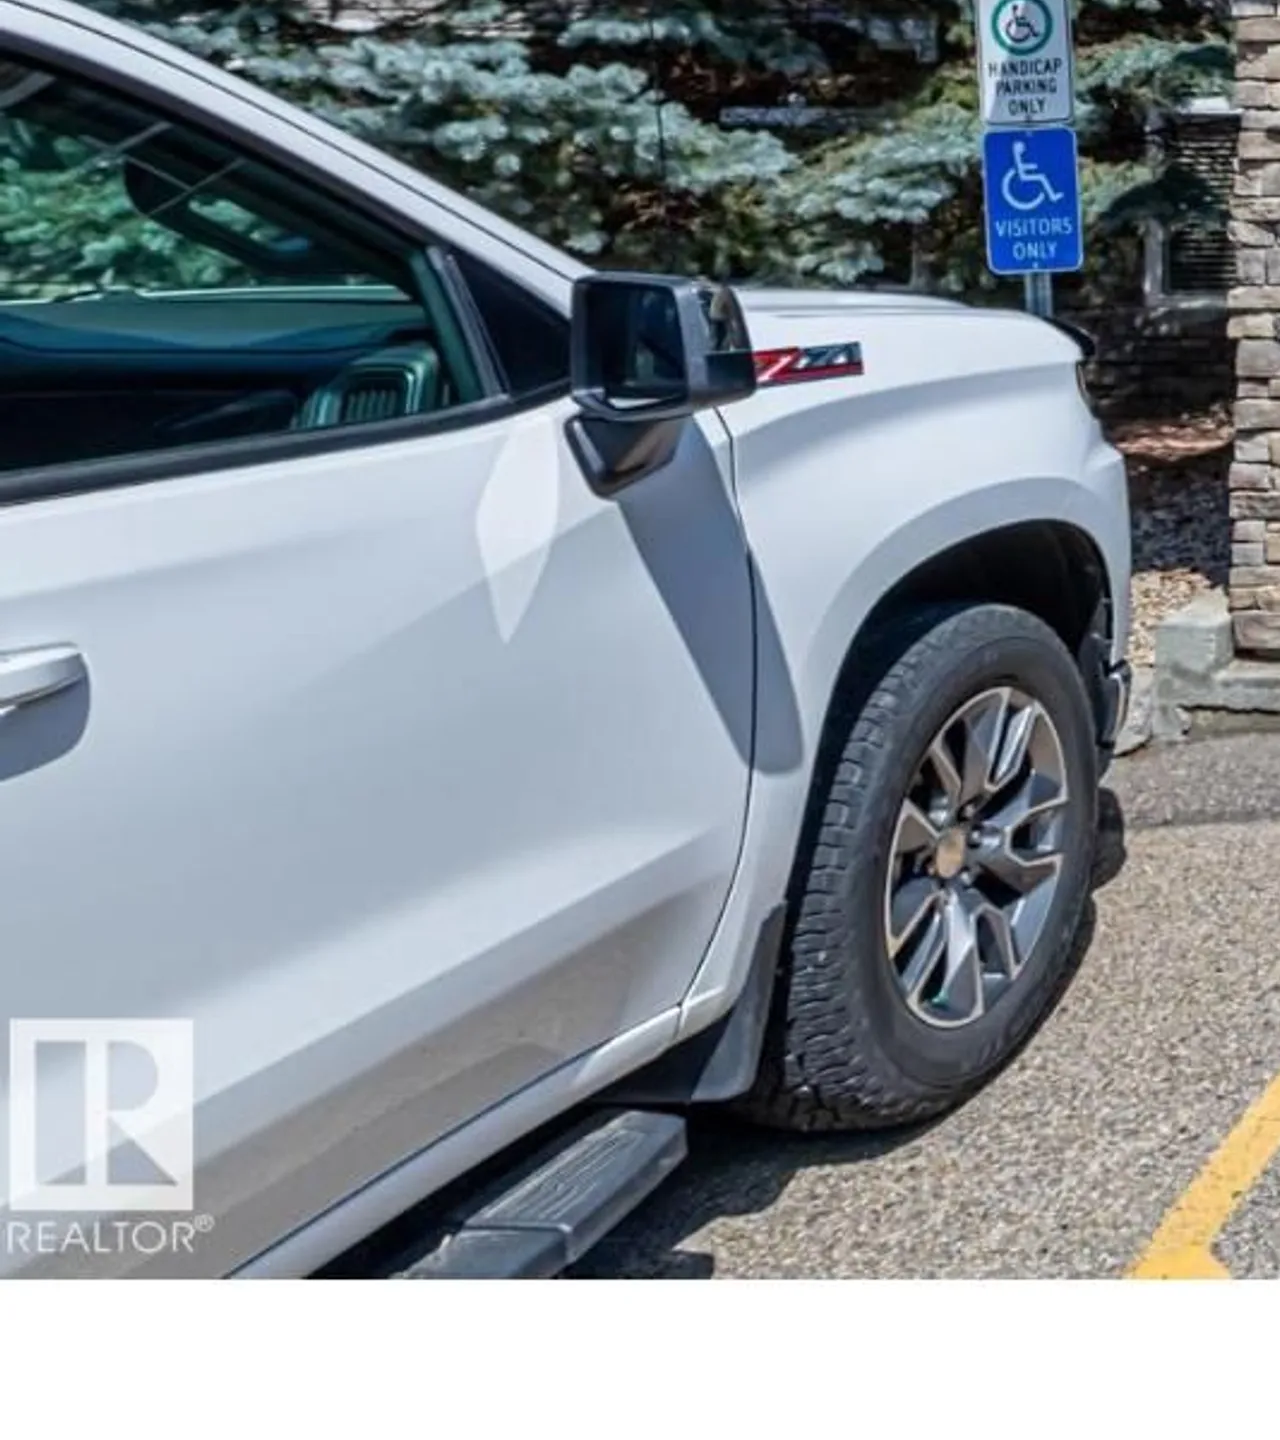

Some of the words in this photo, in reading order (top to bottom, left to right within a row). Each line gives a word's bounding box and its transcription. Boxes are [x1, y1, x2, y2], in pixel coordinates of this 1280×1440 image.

[988, 58, 1062, 77] HANDICAP
[996, 77, 1057, 97] PARKING
[1007, 97, 1046, 116] ONLY
[995, 217, 1073, 238] VISITORS
[1012, 240, 1058, 261] ONLY
